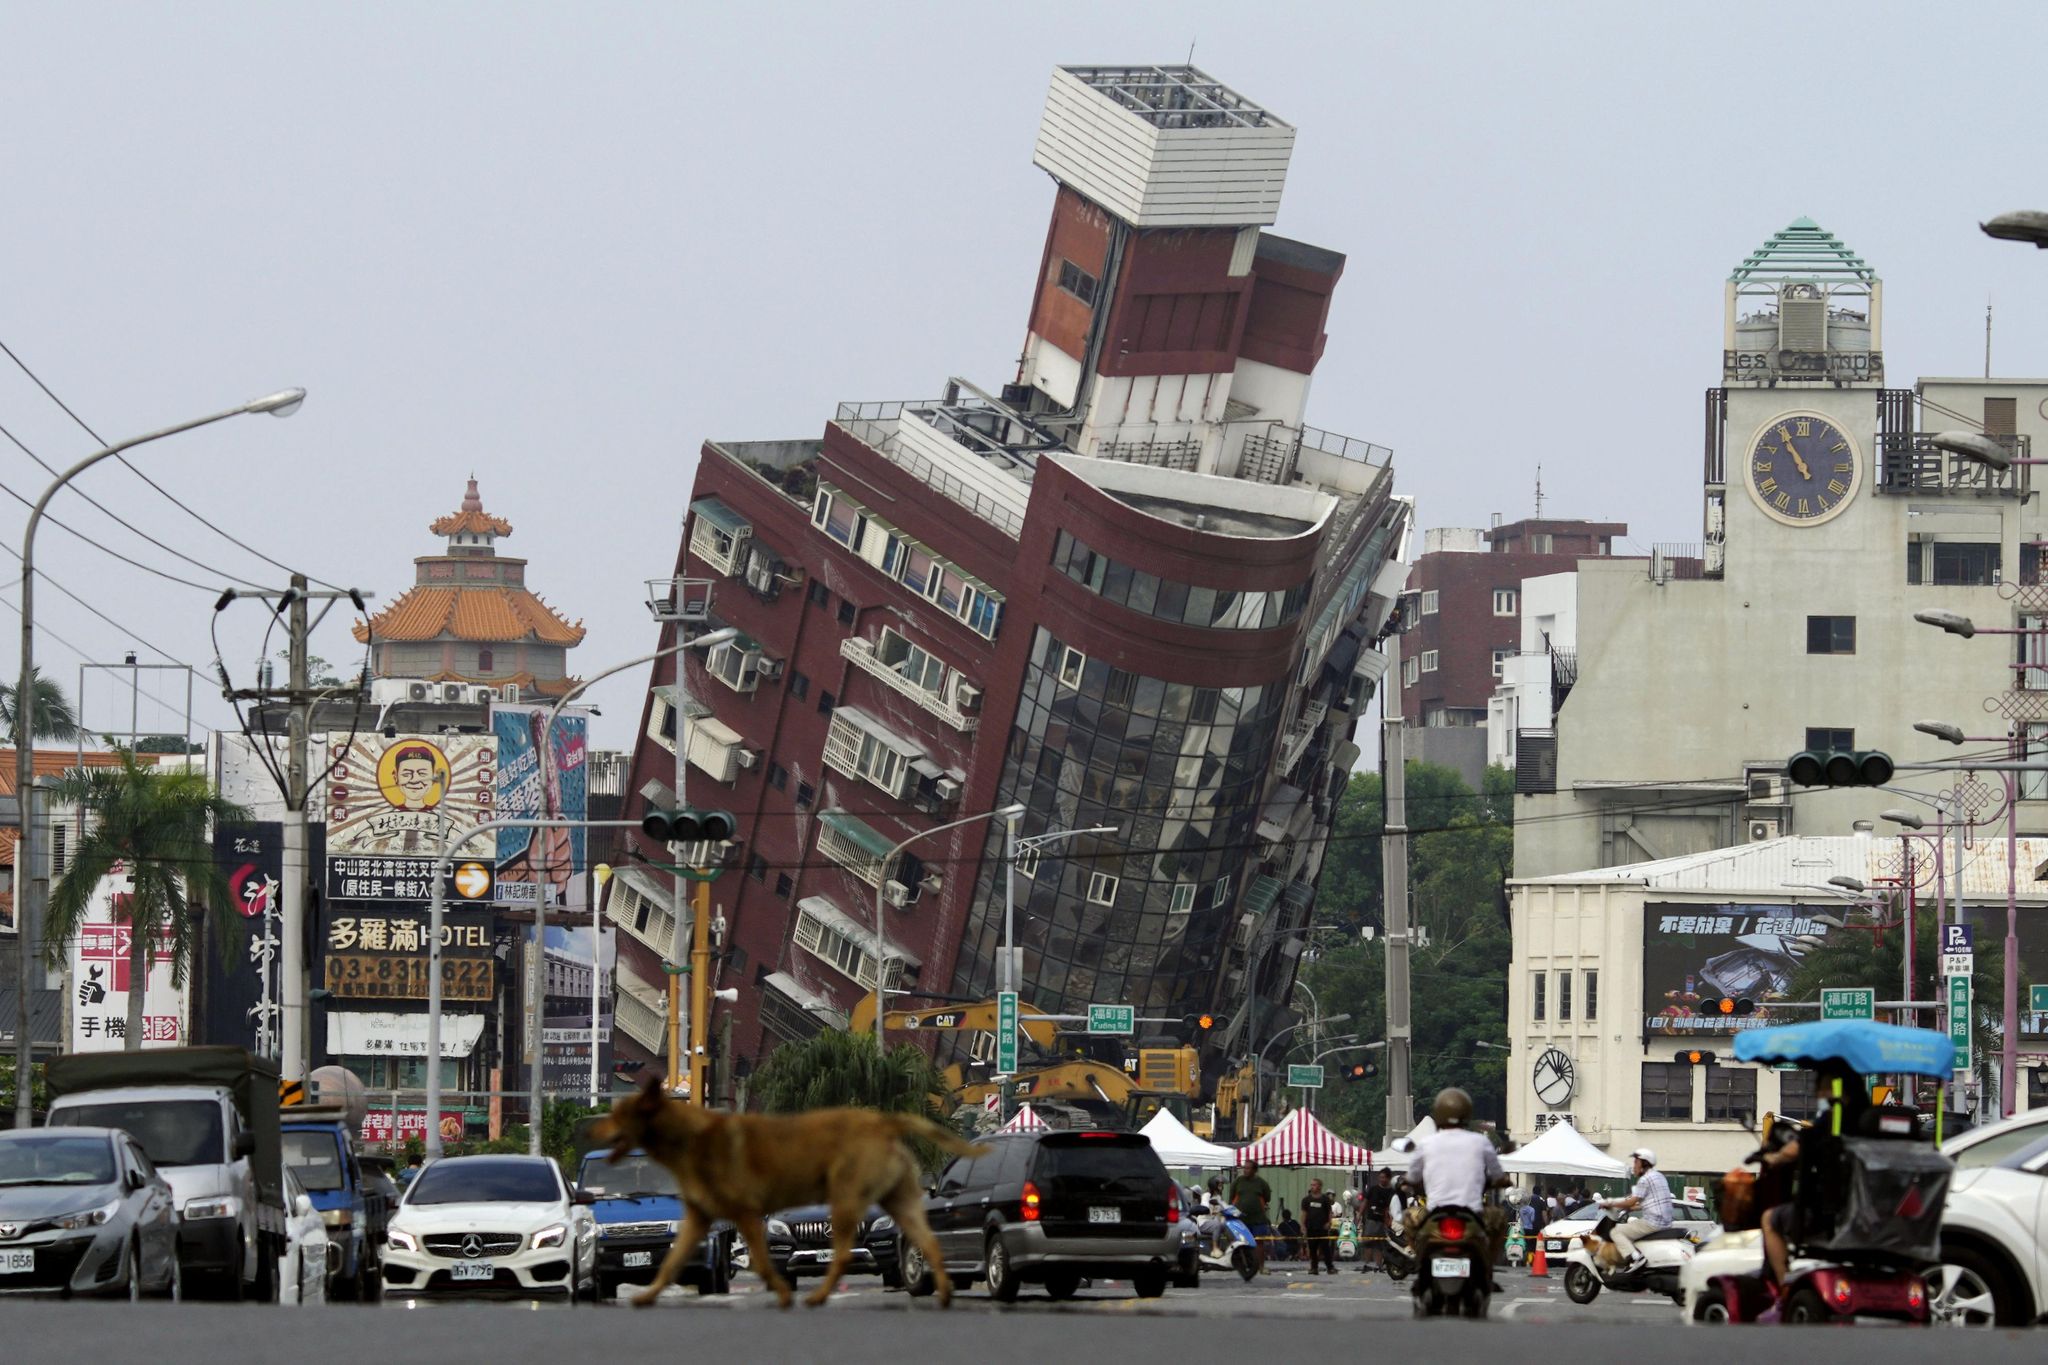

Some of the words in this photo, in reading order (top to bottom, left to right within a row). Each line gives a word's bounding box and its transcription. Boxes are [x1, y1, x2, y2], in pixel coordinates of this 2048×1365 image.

[1724, 349, 1766, 369] Les
[497, 747, 538, 788] 最好吃的
[341, 879, 446, 898] (原住民一條街入)
[1659, 916, 1733, 934] 不要放棄
[328, 918, 419, 951] 多羅滿
[330, 958, 489, 981] 03-831622
[1828, 992, 1868, 1006] 福町路
[936, 1015, 955, 1027] CAT
[1094, 1009, 1128, 1020] 福町路
[1827, 1008, 1854, 1018] Fuding
[1953, 989, 1967, 1036] 重慶路
[1124, 1058, 1138, 1072] AT
[362, 1113, 428, 1130] 胖老爹美式炸
